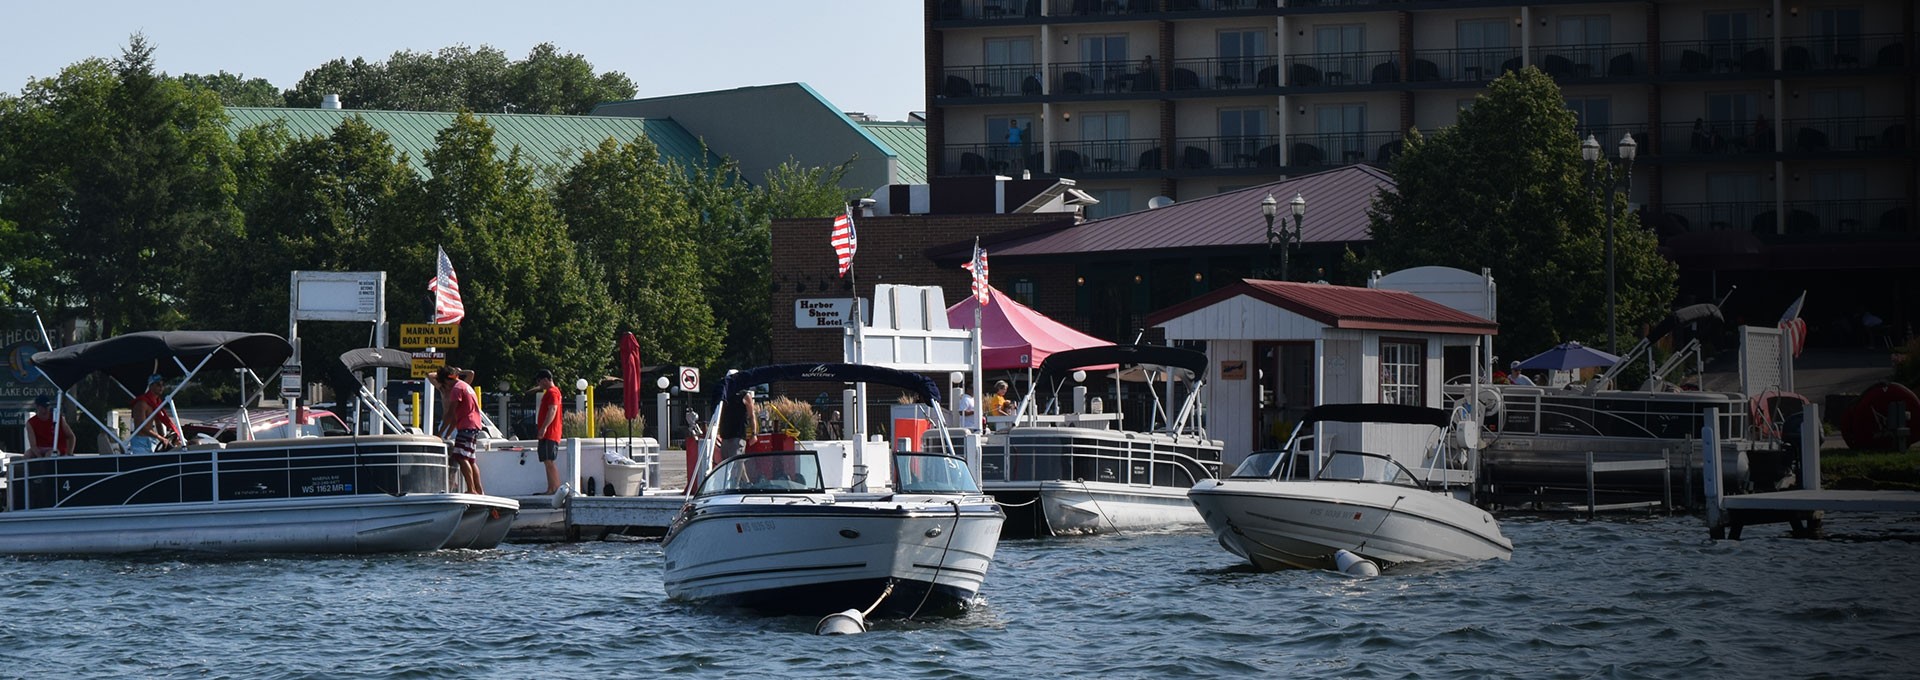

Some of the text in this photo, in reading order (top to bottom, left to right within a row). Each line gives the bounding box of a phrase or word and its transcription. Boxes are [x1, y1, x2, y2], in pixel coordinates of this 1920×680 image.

[800, 300, 833, 309] Harbor
[808, 309, 839, 317] Shores
[817, 317, 842, 326] Hotel
[406, 327, 452, 335] MARINA BAY
[402, 336, 456, 345] BOAT RENTALS
[0, 386, 56, 397] LAKE GENEVA
[62, 480, 71, 490] 4
[302, 484, 345, 493] WS 1162 MR
